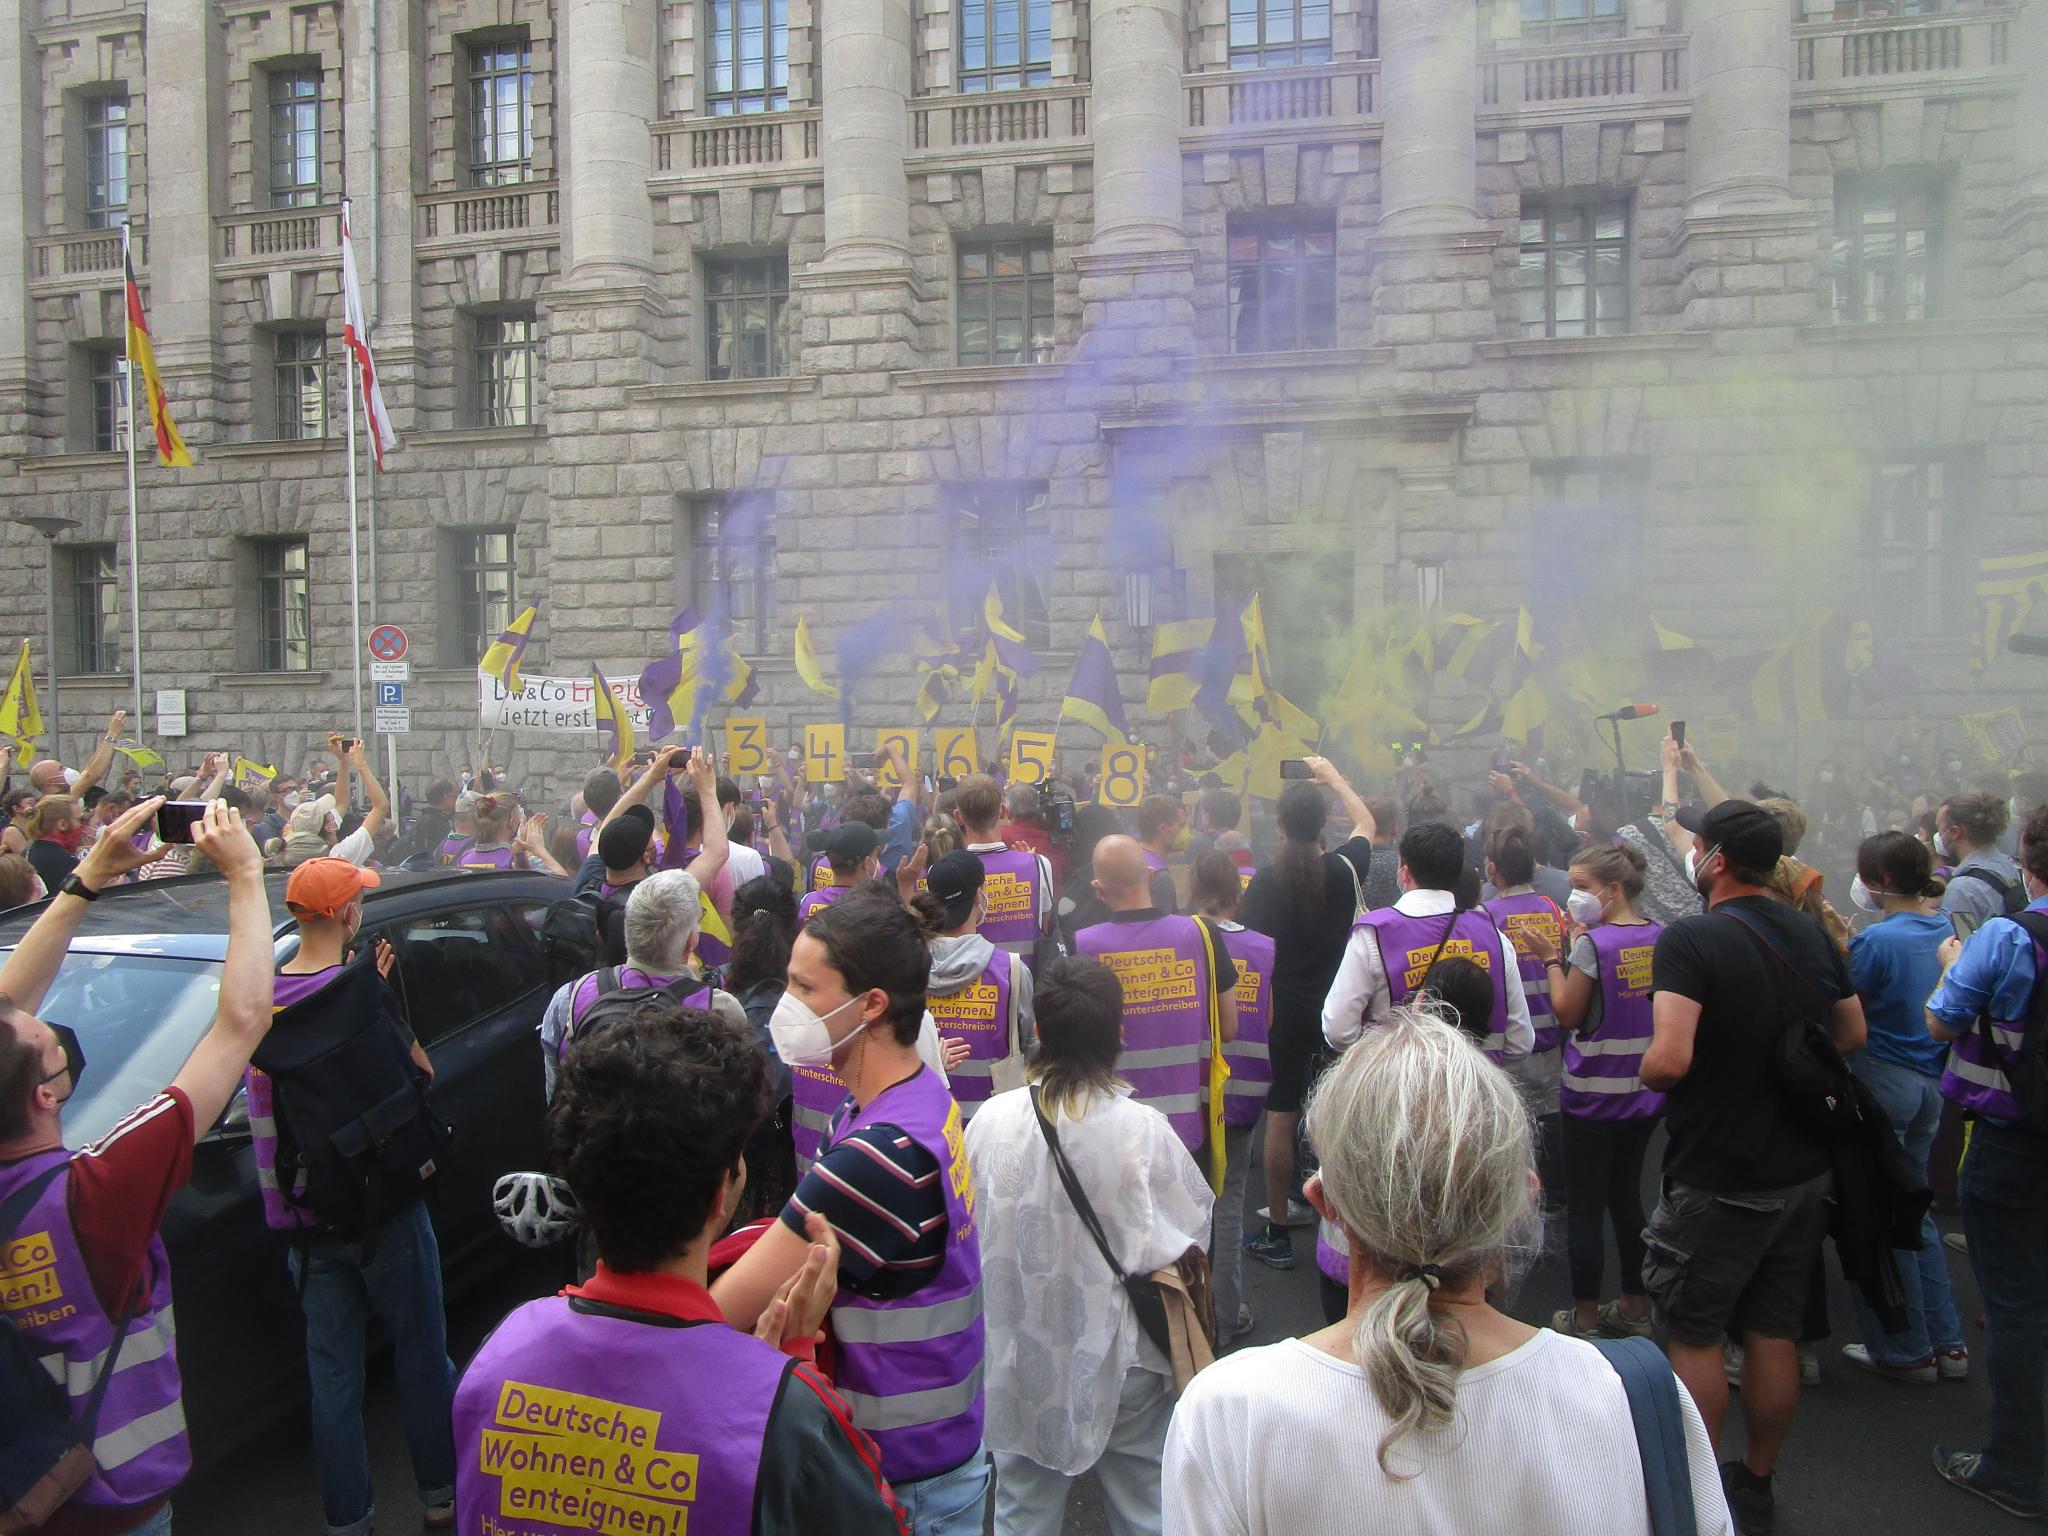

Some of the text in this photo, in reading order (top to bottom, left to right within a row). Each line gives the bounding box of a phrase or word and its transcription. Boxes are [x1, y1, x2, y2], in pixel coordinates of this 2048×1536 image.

[383, 685, 396, 702] P
[501, 708, 592, 727] jetzt erst
[732, 724, 765, 772] 3
[809, 732, 837, 779] 4
[943, 732, 973, 778] 6
[1016, 738, 1049, 785] 5
[1103, 750, 1140, 805] 8
[1014, 884, 1030, 894] Co
[988, 897, 1029, 912] eignen!
[1103, 951, 1172, 968] Deutsche
[1120, 963, 1193, 985] hnen & Co
[1242, 974, 1259, 985] Co
[977, 987, 997, 1000] Co
[1123, 979, 1193, 1000] nteignen!
[929, 1002, 993, 1018] nteignen!
[1122, 999, 1200, 1015] unterschreiben
[10, 1243, 49, 1269] Co
[501, 1388, 648, 1448] Deutsche
[484, 1436, 691, 1493] Wohnen & Co
[508, 1486, 682, 1536] enteignen!
